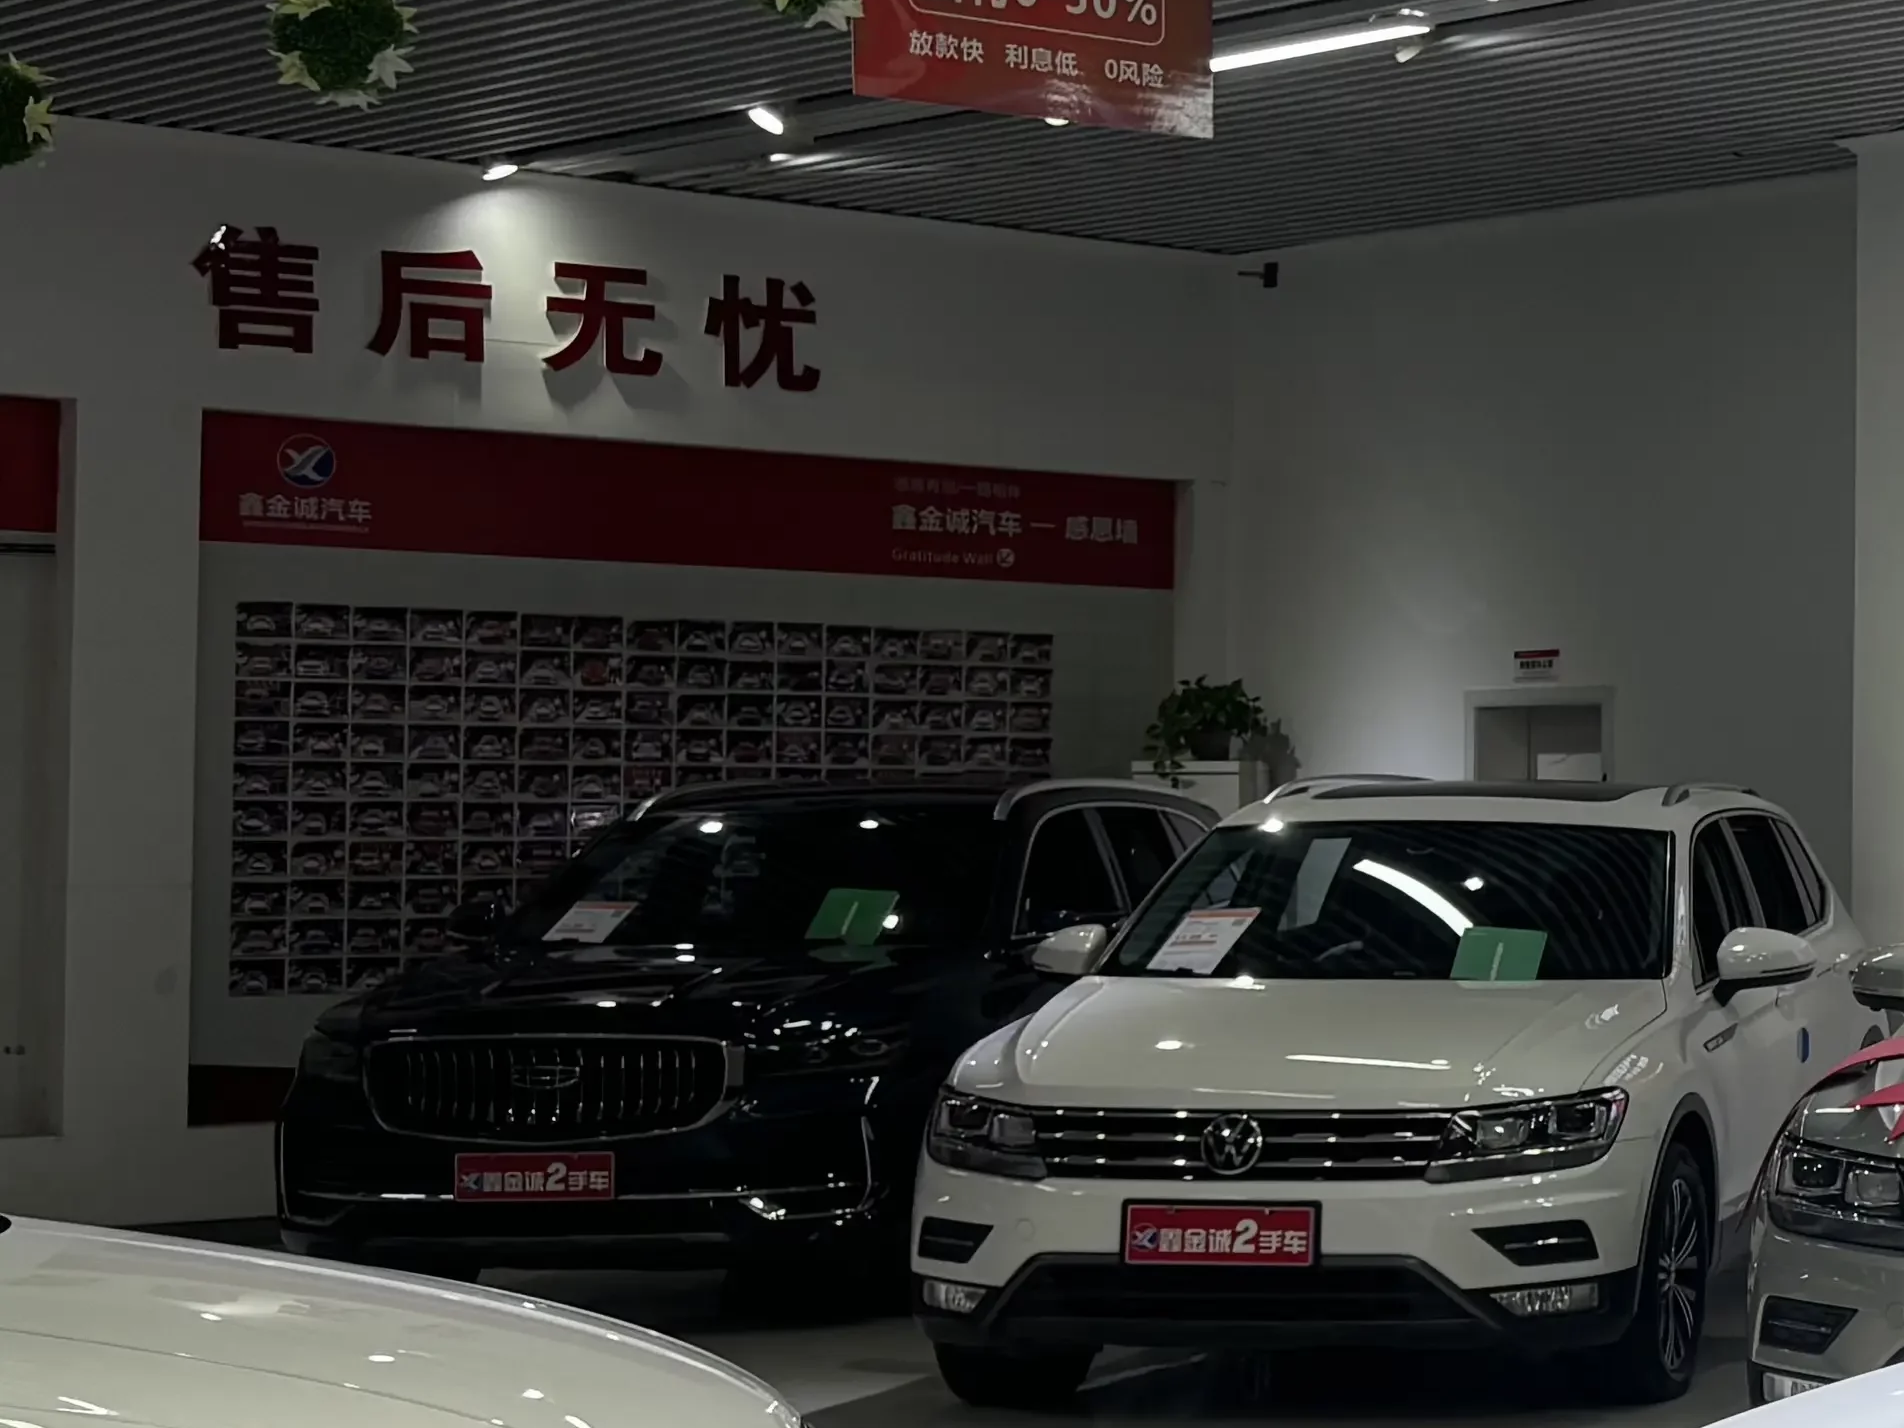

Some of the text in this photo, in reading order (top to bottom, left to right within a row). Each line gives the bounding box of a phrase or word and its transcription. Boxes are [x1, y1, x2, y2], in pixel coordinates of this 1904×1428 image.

[909, 29, 1165, 88] 放款快 利息低 0风险
[192, 224, 821, 392] 售后无忧
[239, 491, 373, 524] 鑫金诚汽车
[891, 503, 1023, 538] 鑫金诚汽车
[1158, 1219, 1309, 1257] 鑫金诚2手车
